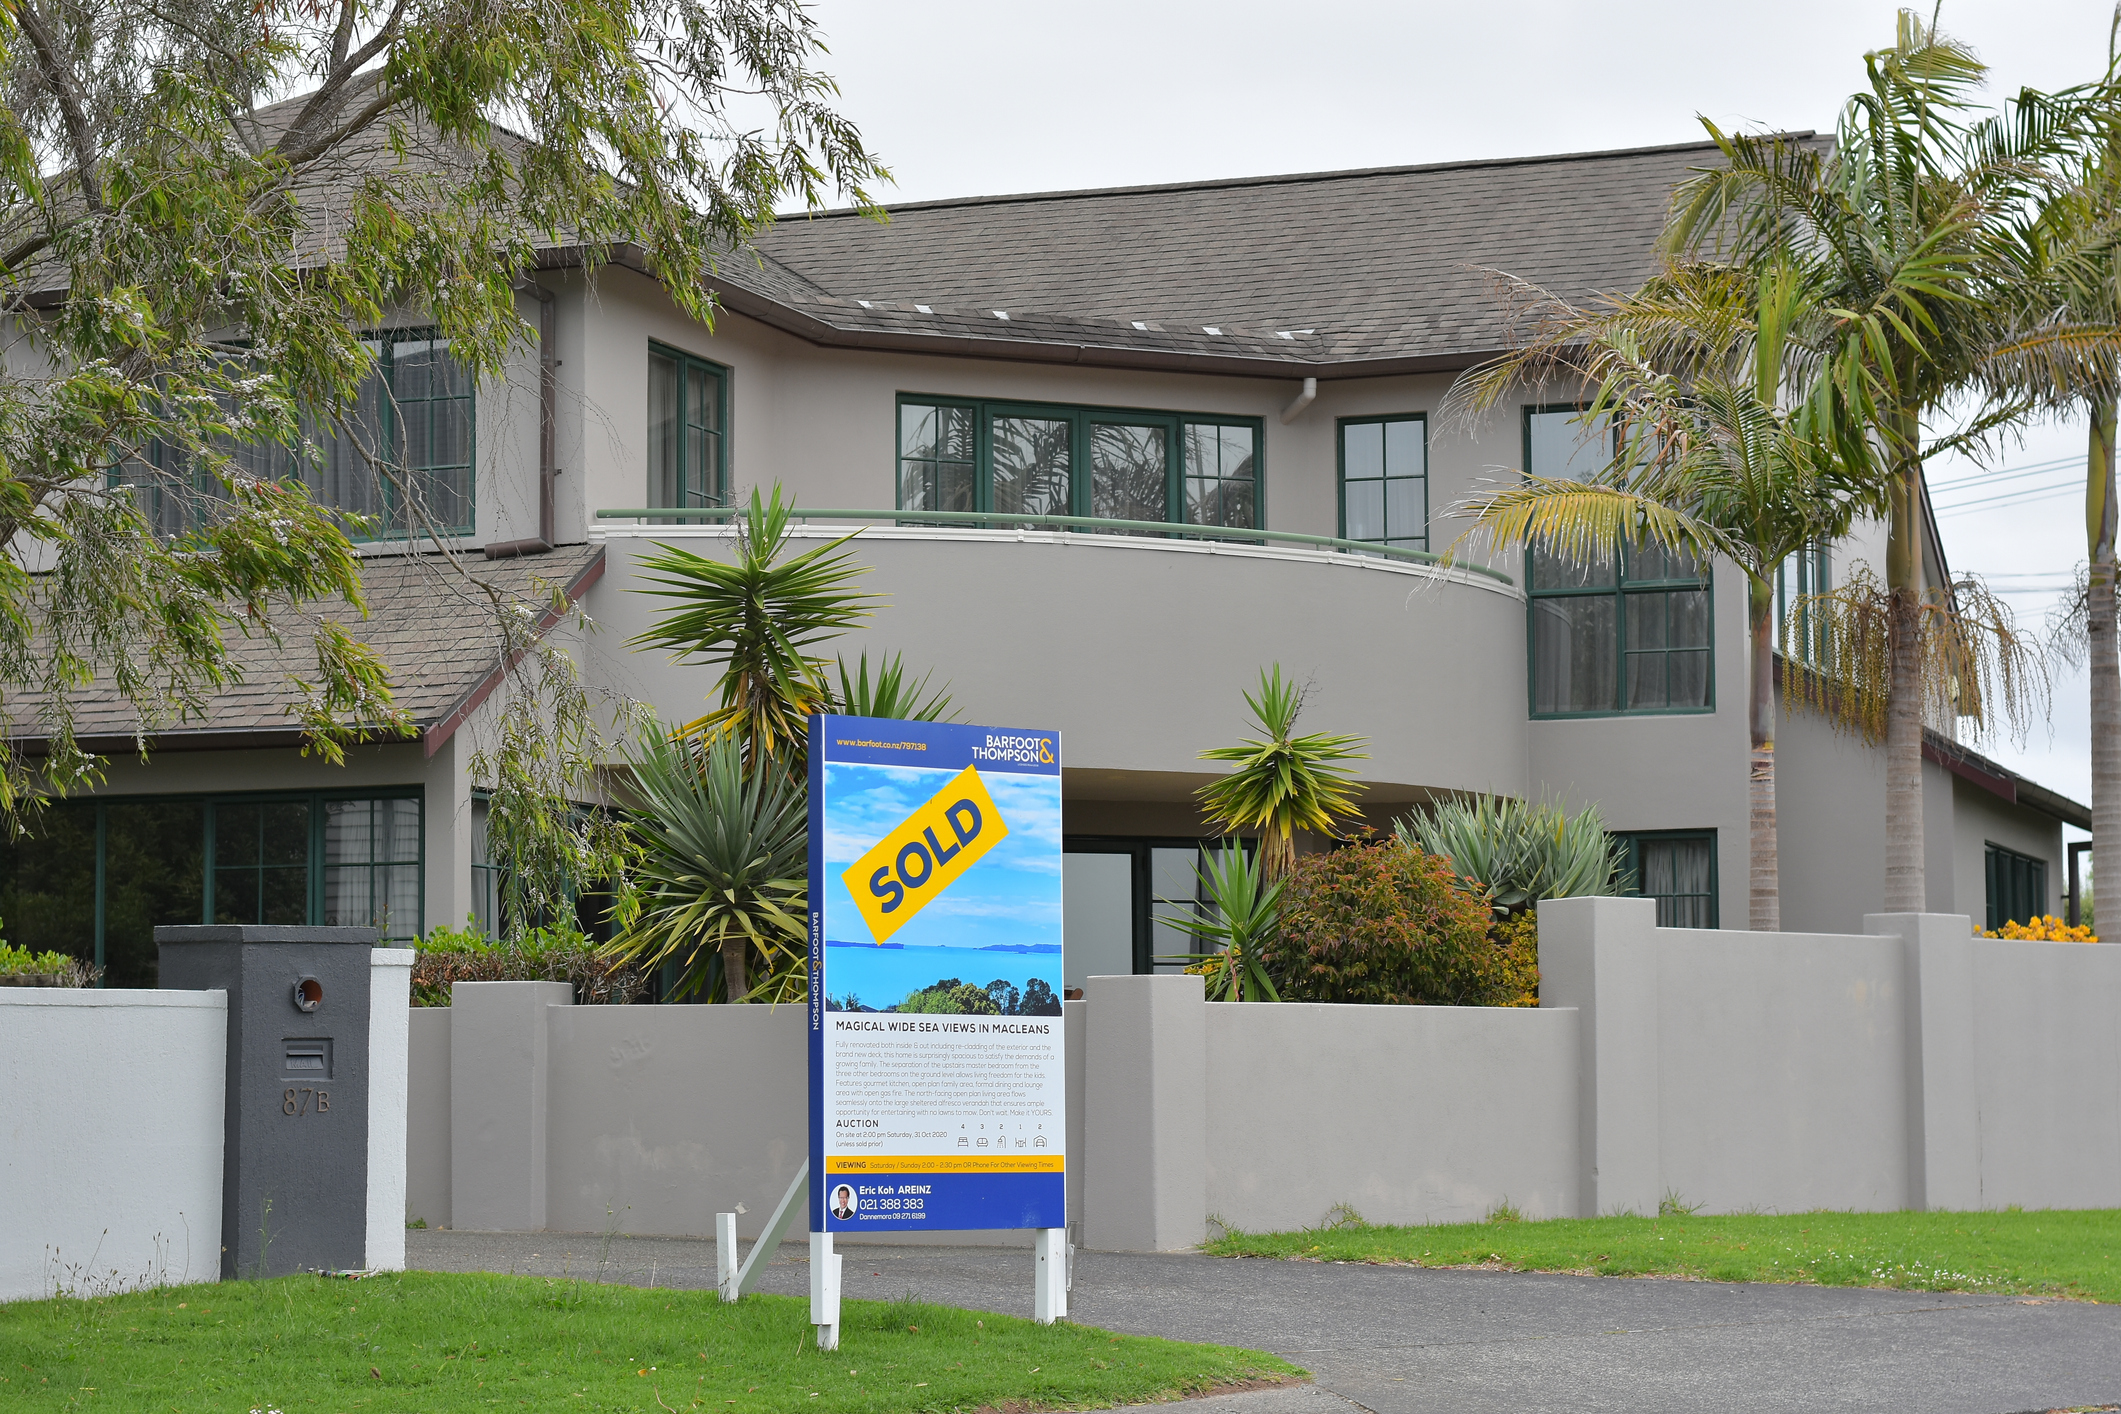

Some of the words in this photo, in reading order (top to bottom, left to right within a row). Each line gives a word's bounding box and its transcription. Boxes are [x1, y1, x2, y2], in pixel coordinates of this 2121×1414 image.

[837, 739, 926, 751] www.barfoot.co.nz/797138
[986, 735, 1040, 750] BARFOOT
[1040, 738, 1054, 764] &
[972, 747, 1039, 762] THOMPSON
[869, 799, 982, 913] SOLD
[836, 1021, 885, 1031] MAGICAL
[888, 1022, 915, 1032] WIDE
[918, 1023, 939, 1032] SEA
[942, 1023, 976, 1033] VIEWS
[979, 1024, 989, 1033] IN
[993, 1024, 1049, 1034] MACLEANS
[836, 1041, 848, 1049] Fully
[931, 1043, 954, 1051] including
[956, 1043, 987, 1052] re-cladding
[919, 1053, 950, 1061] surprisingly
[836, 1061, 858, 1069] growing
[921, 1072, 940, 1080] ground
[974, 1072, 987, 1080] living
[863, 1081, 887, 1089] gourmet
[995, 1082, 1011, 1090] dining
[1025, 1082, 1043, 1090] lounge
[917, 1090, 952, 1099] north-facing
[982, 1091, 996, 1099] living
[895, 1100, 909, 1108] large
[881, 1110, 915, 1118] entertaining
[860, 1186, 875, 1194] Eric
[878, 1186, 894, 1194] Koh
[898, 1185, 931, 1194] AREINZ
[860, 1199, 878, 1210] 021
[880, 1199, 900, 1210] 388
[903, 1198, 923, 1209] 383
